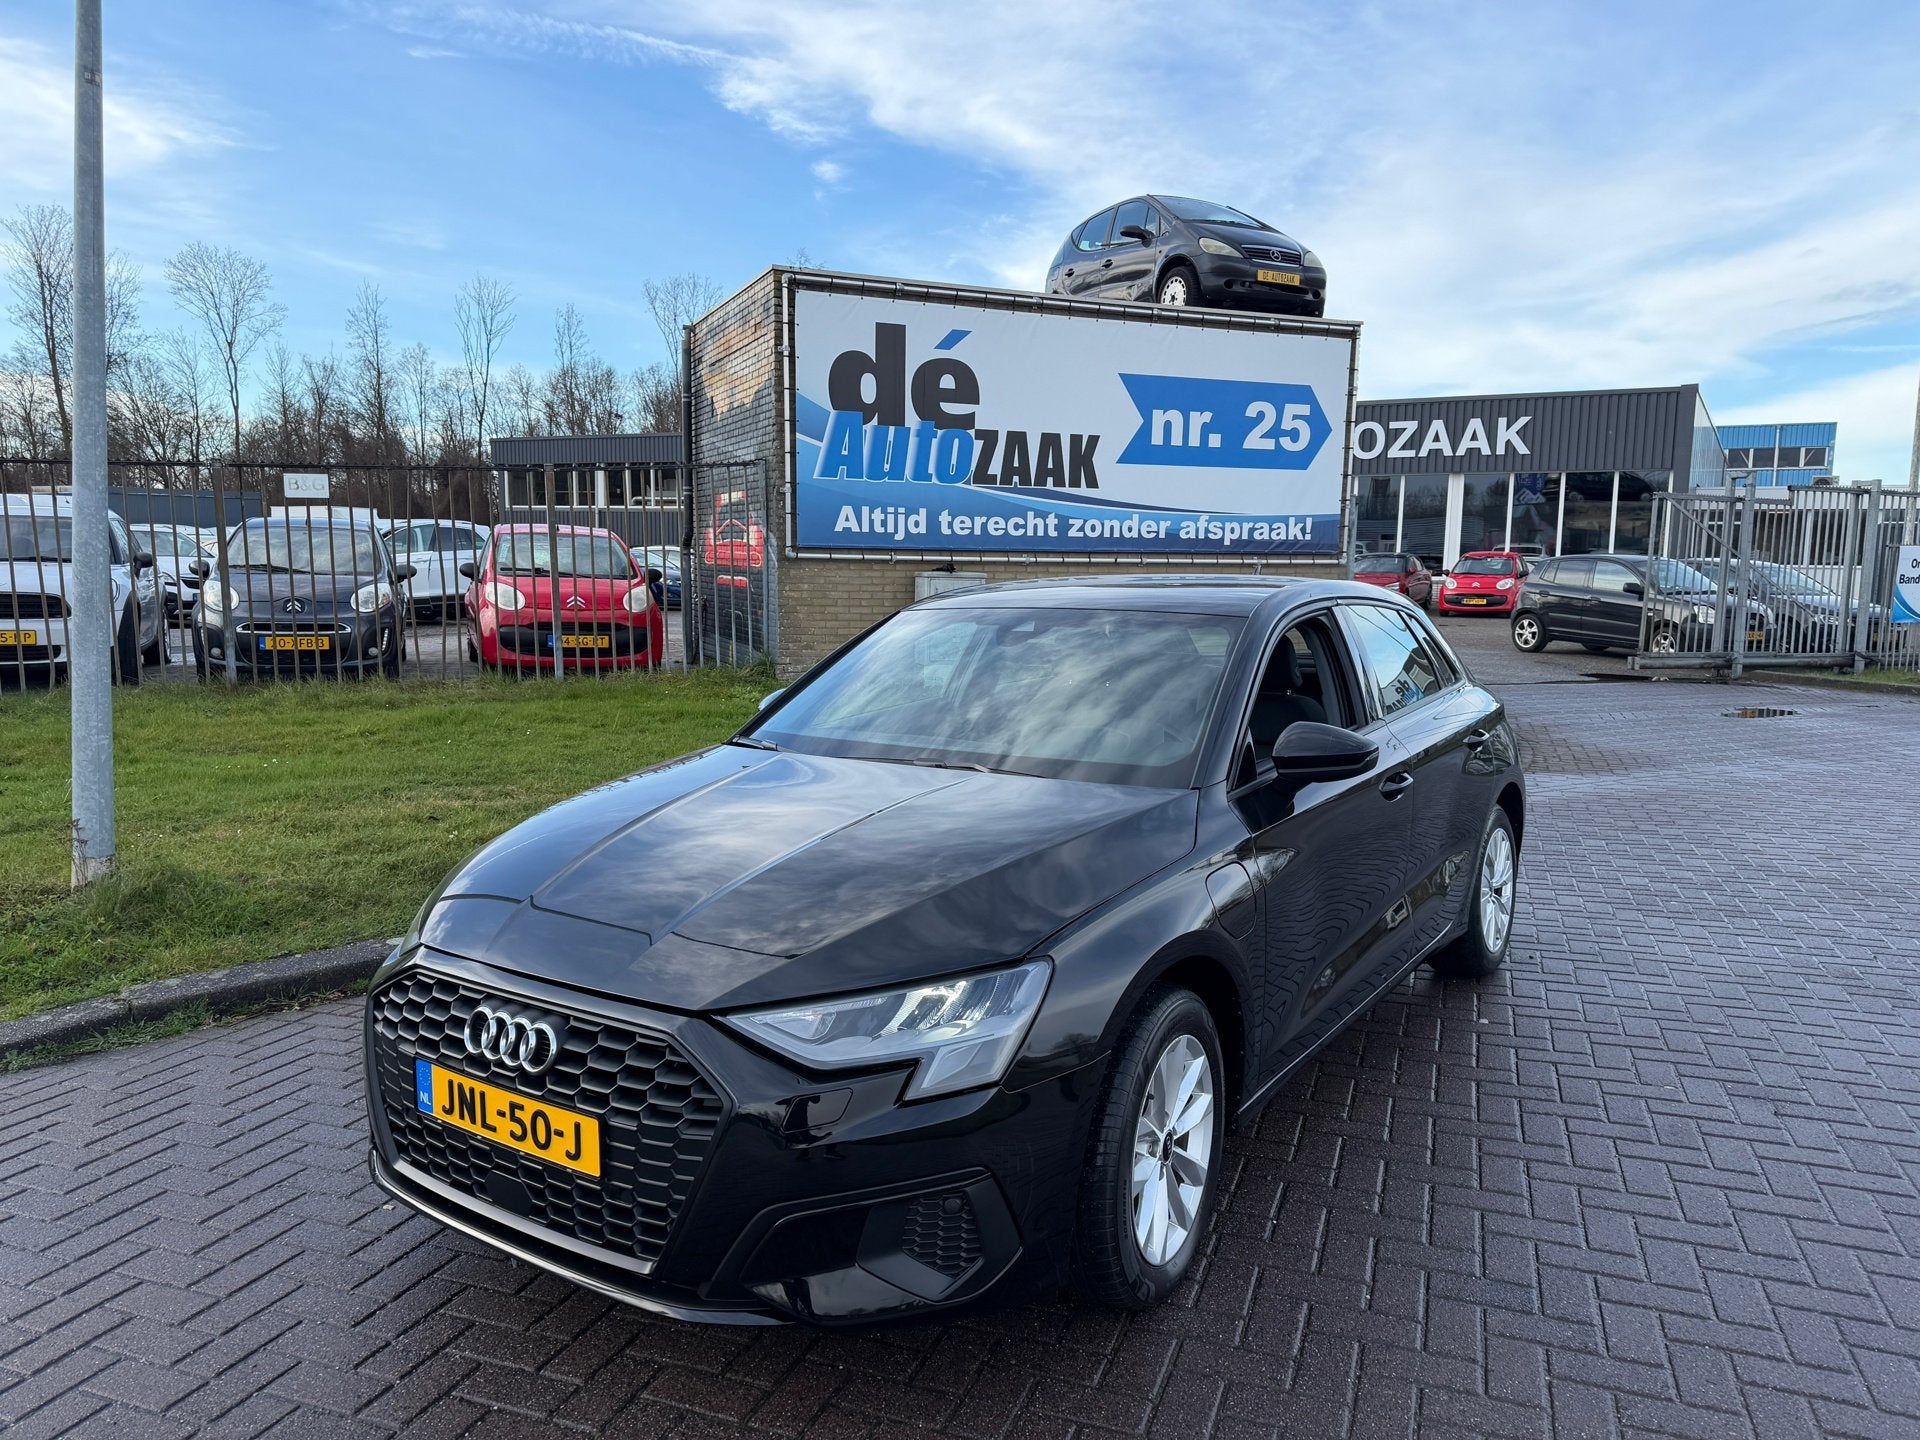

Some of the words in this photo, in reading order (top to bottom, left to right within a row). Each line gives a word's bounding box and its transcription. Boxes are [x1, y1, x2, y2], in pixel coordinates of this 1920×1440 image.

[828, 322, 980, 430] dé
[1151, 408, 1222, 448] nr.
[1242, 401, 1312, 451] 25
[288, 475, 325, 491] B&G
[834, 505, 927, 540] Altijd
[939, 508, 1058, 537] terecht
[1067, 514, 1171, 539] zonder
[1179, 516, 1313, 546] afspraak!
[419, 1091, 431, 1106] NL
[441, 1078, 582, 1162] JNL-50-J
